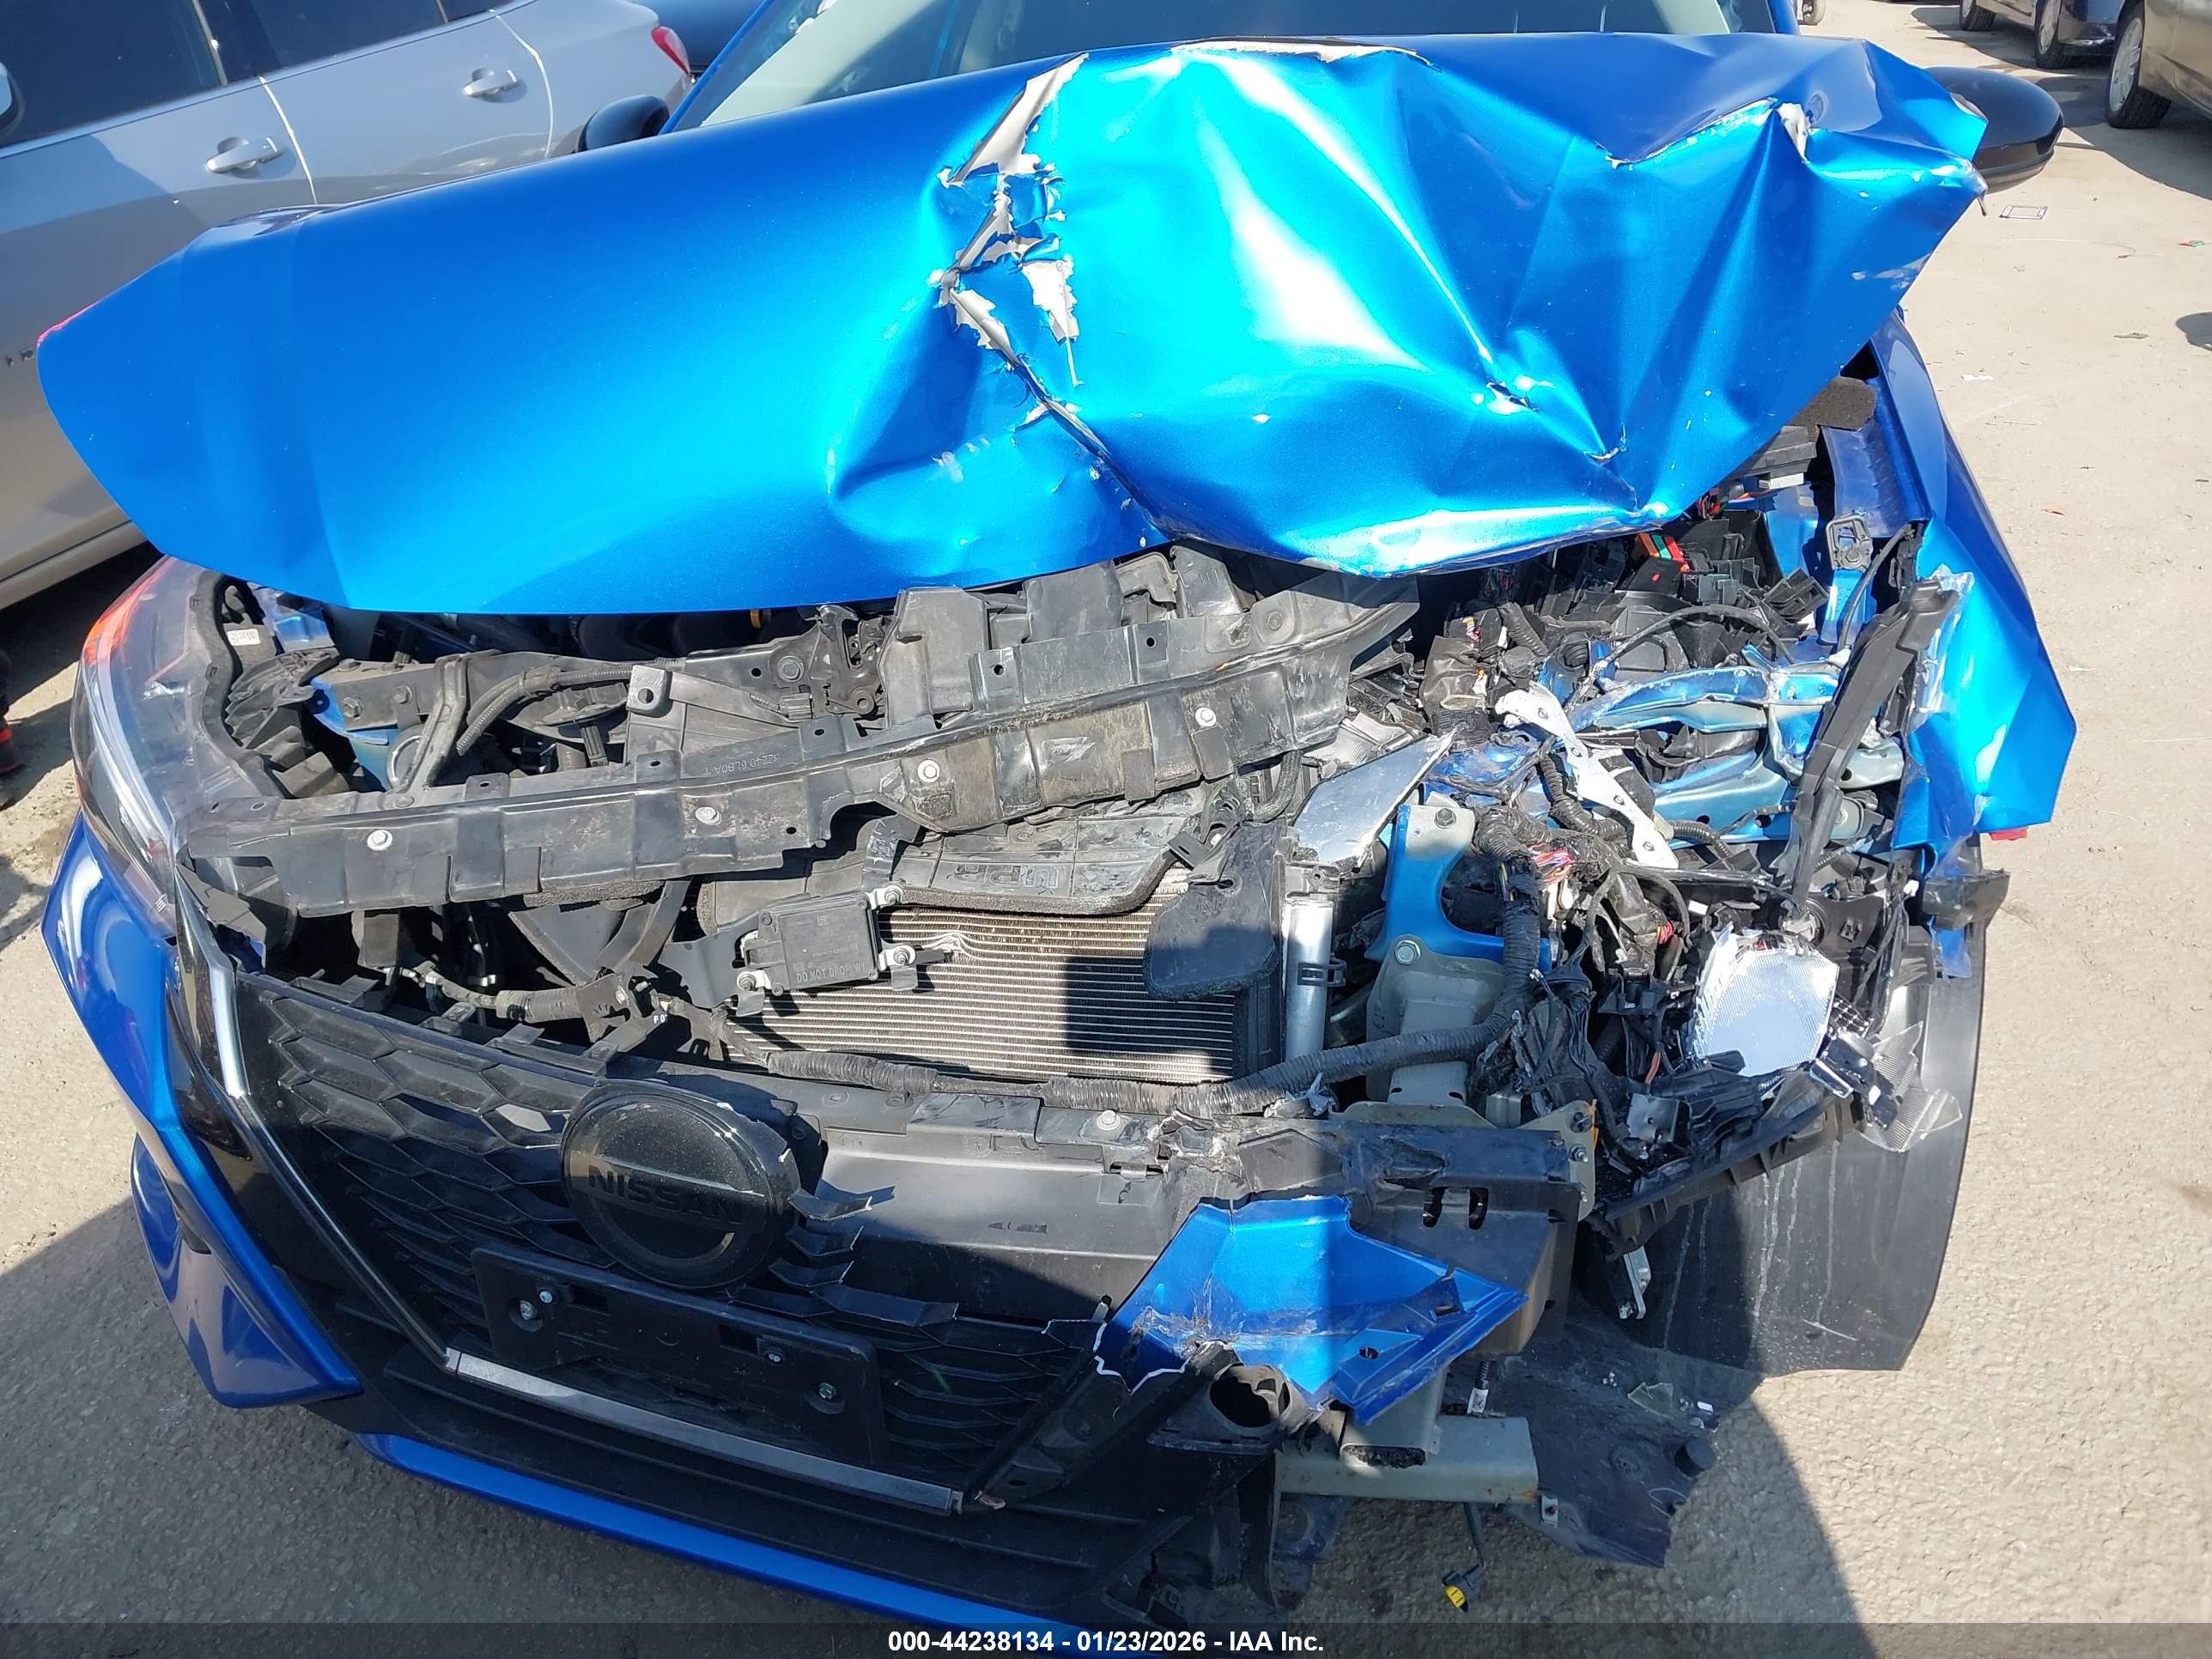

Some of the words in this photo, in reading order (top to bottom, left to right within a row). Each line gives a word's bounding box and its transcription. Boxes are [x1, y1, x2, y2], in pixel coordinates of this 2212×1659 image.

[796, 971, 808, 983] DO
[810, 968, 827, 981] NOT
[587, 1164, 744, 1225] NISSAN
